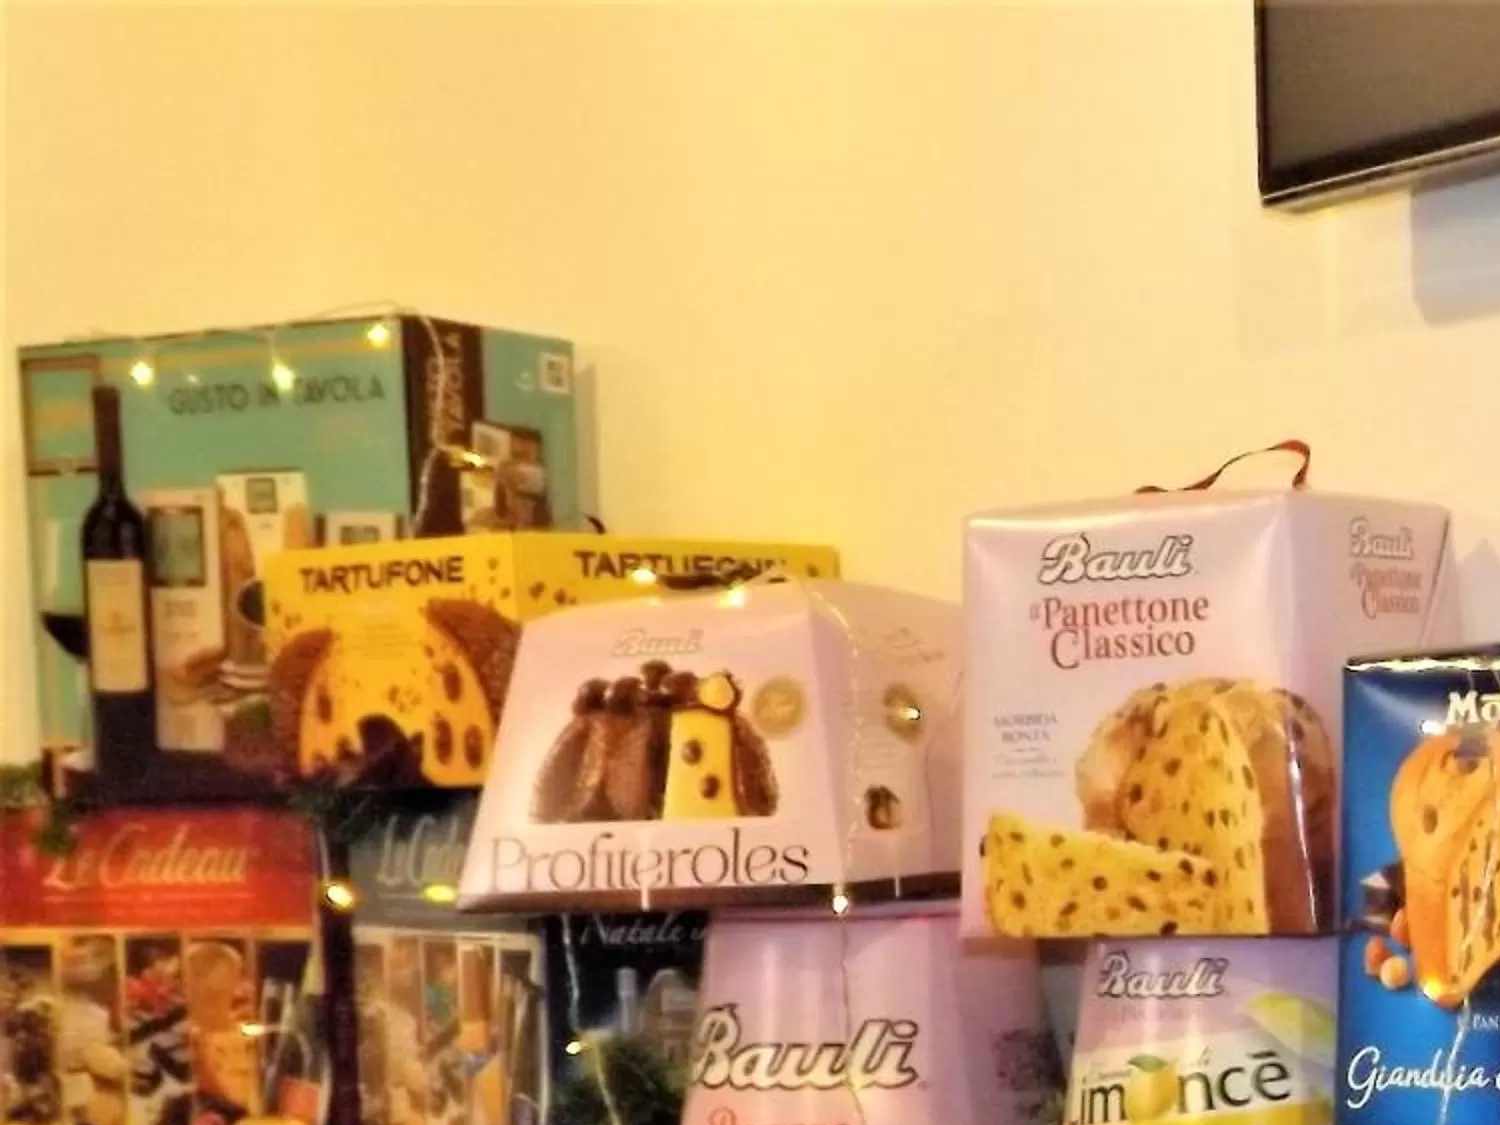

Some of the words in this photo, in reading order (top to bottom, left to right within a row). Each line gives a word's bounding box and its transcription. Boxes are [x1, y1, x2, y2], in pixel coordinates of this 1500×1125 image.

[169, 383, 249, 415] GUSTO
[1038, 531, 1194, 584] Bauli
[1347, 513, 1415, 560] Bauli
[299, 556, 464, 595] TARTUFONE
[1042, 596, 1209, 629] Panettone
[1051, 624, 1195, 669] Classico
[101, 822, 249, 888] Cadeau
[491, 827, 810, 893] Profiteroles
[1098, 950, 1230, 1000] Bauli
[692, 1003, 920, 1091] Bauli
